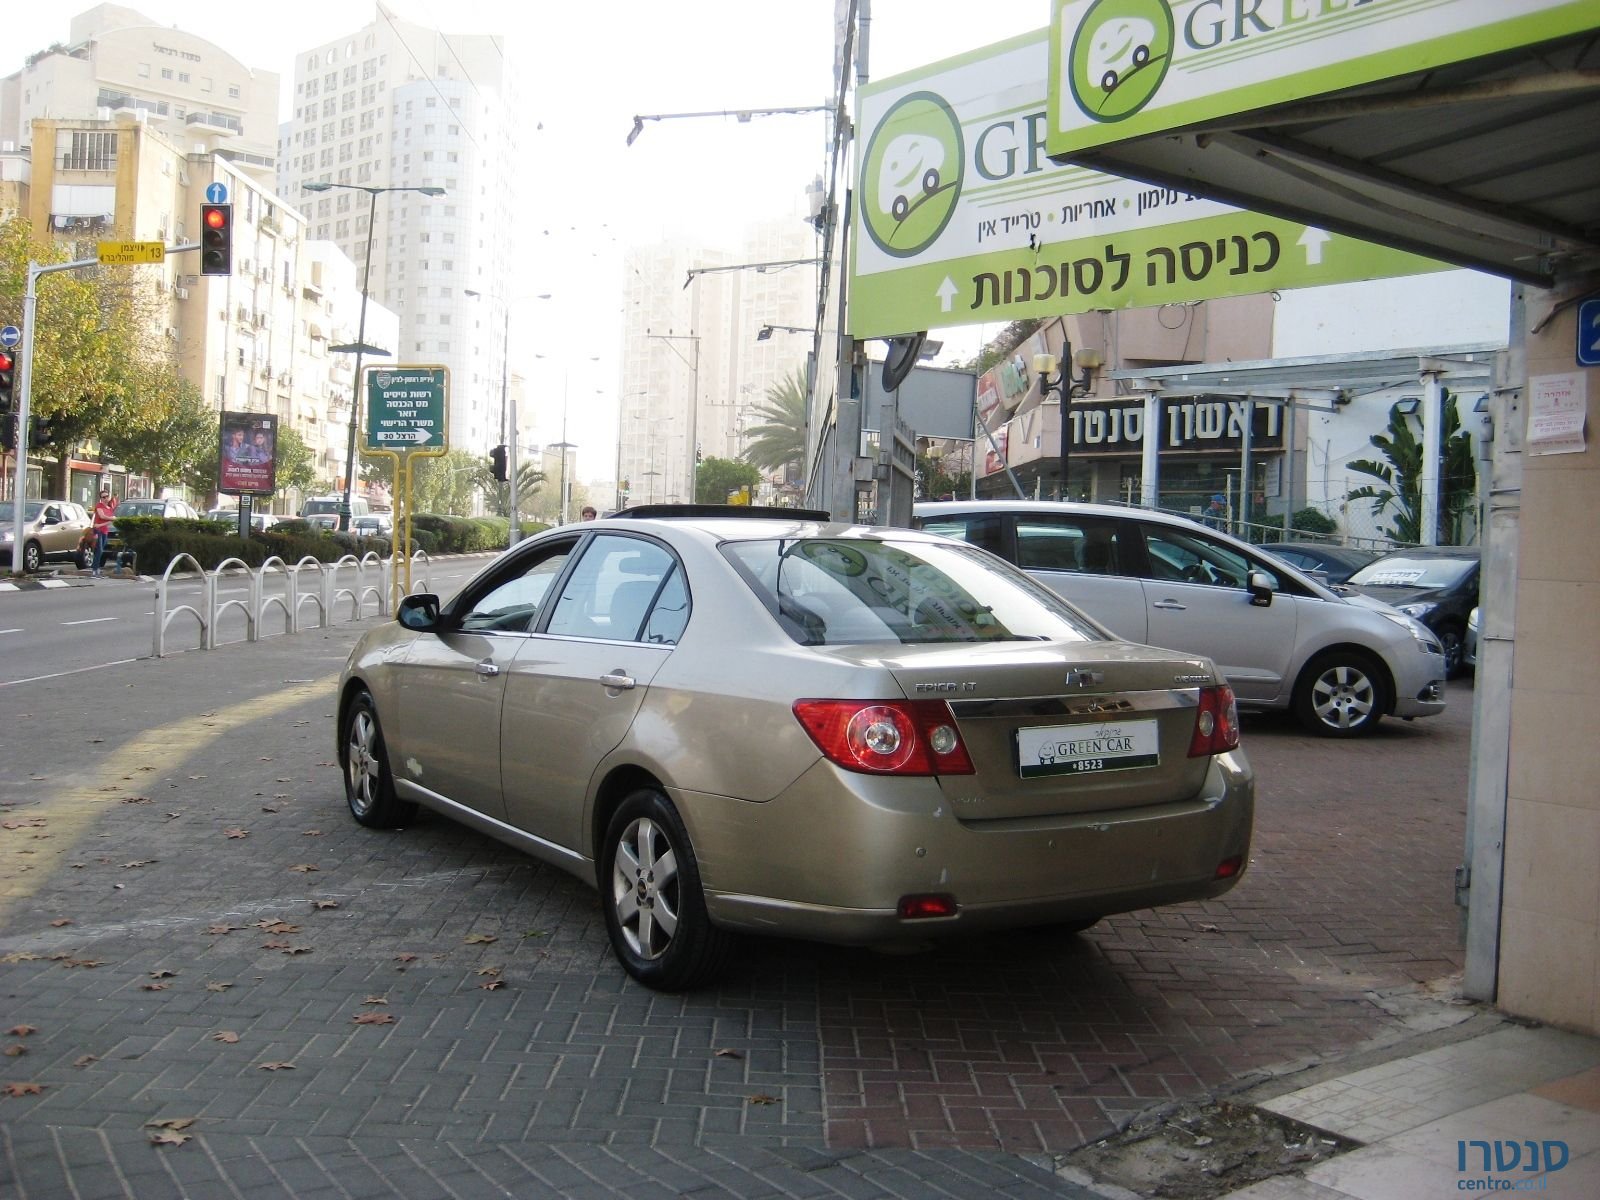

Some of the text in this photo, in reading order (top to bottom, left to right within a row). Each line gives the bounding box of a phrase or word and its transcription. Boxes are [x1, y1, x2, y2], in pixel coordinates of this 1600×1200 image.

[1061, 198, 1116, 224] אחריות
[978, 219, 997, 242] אין
[1001, 211, 1041, 234] טרייד
[106, 253, 135, 261] מוהליבר
[121, 244, 140, 253] ויצמן
[151, 247, 161, 258] 13
[970, 231, 1280, 310] כניסה לסוכנות
[1168, 401, 1278, 446] ראשון
[915, 682, 957, 692] EPICA
[1058, 738, 1132, 756] GREEN CAR
